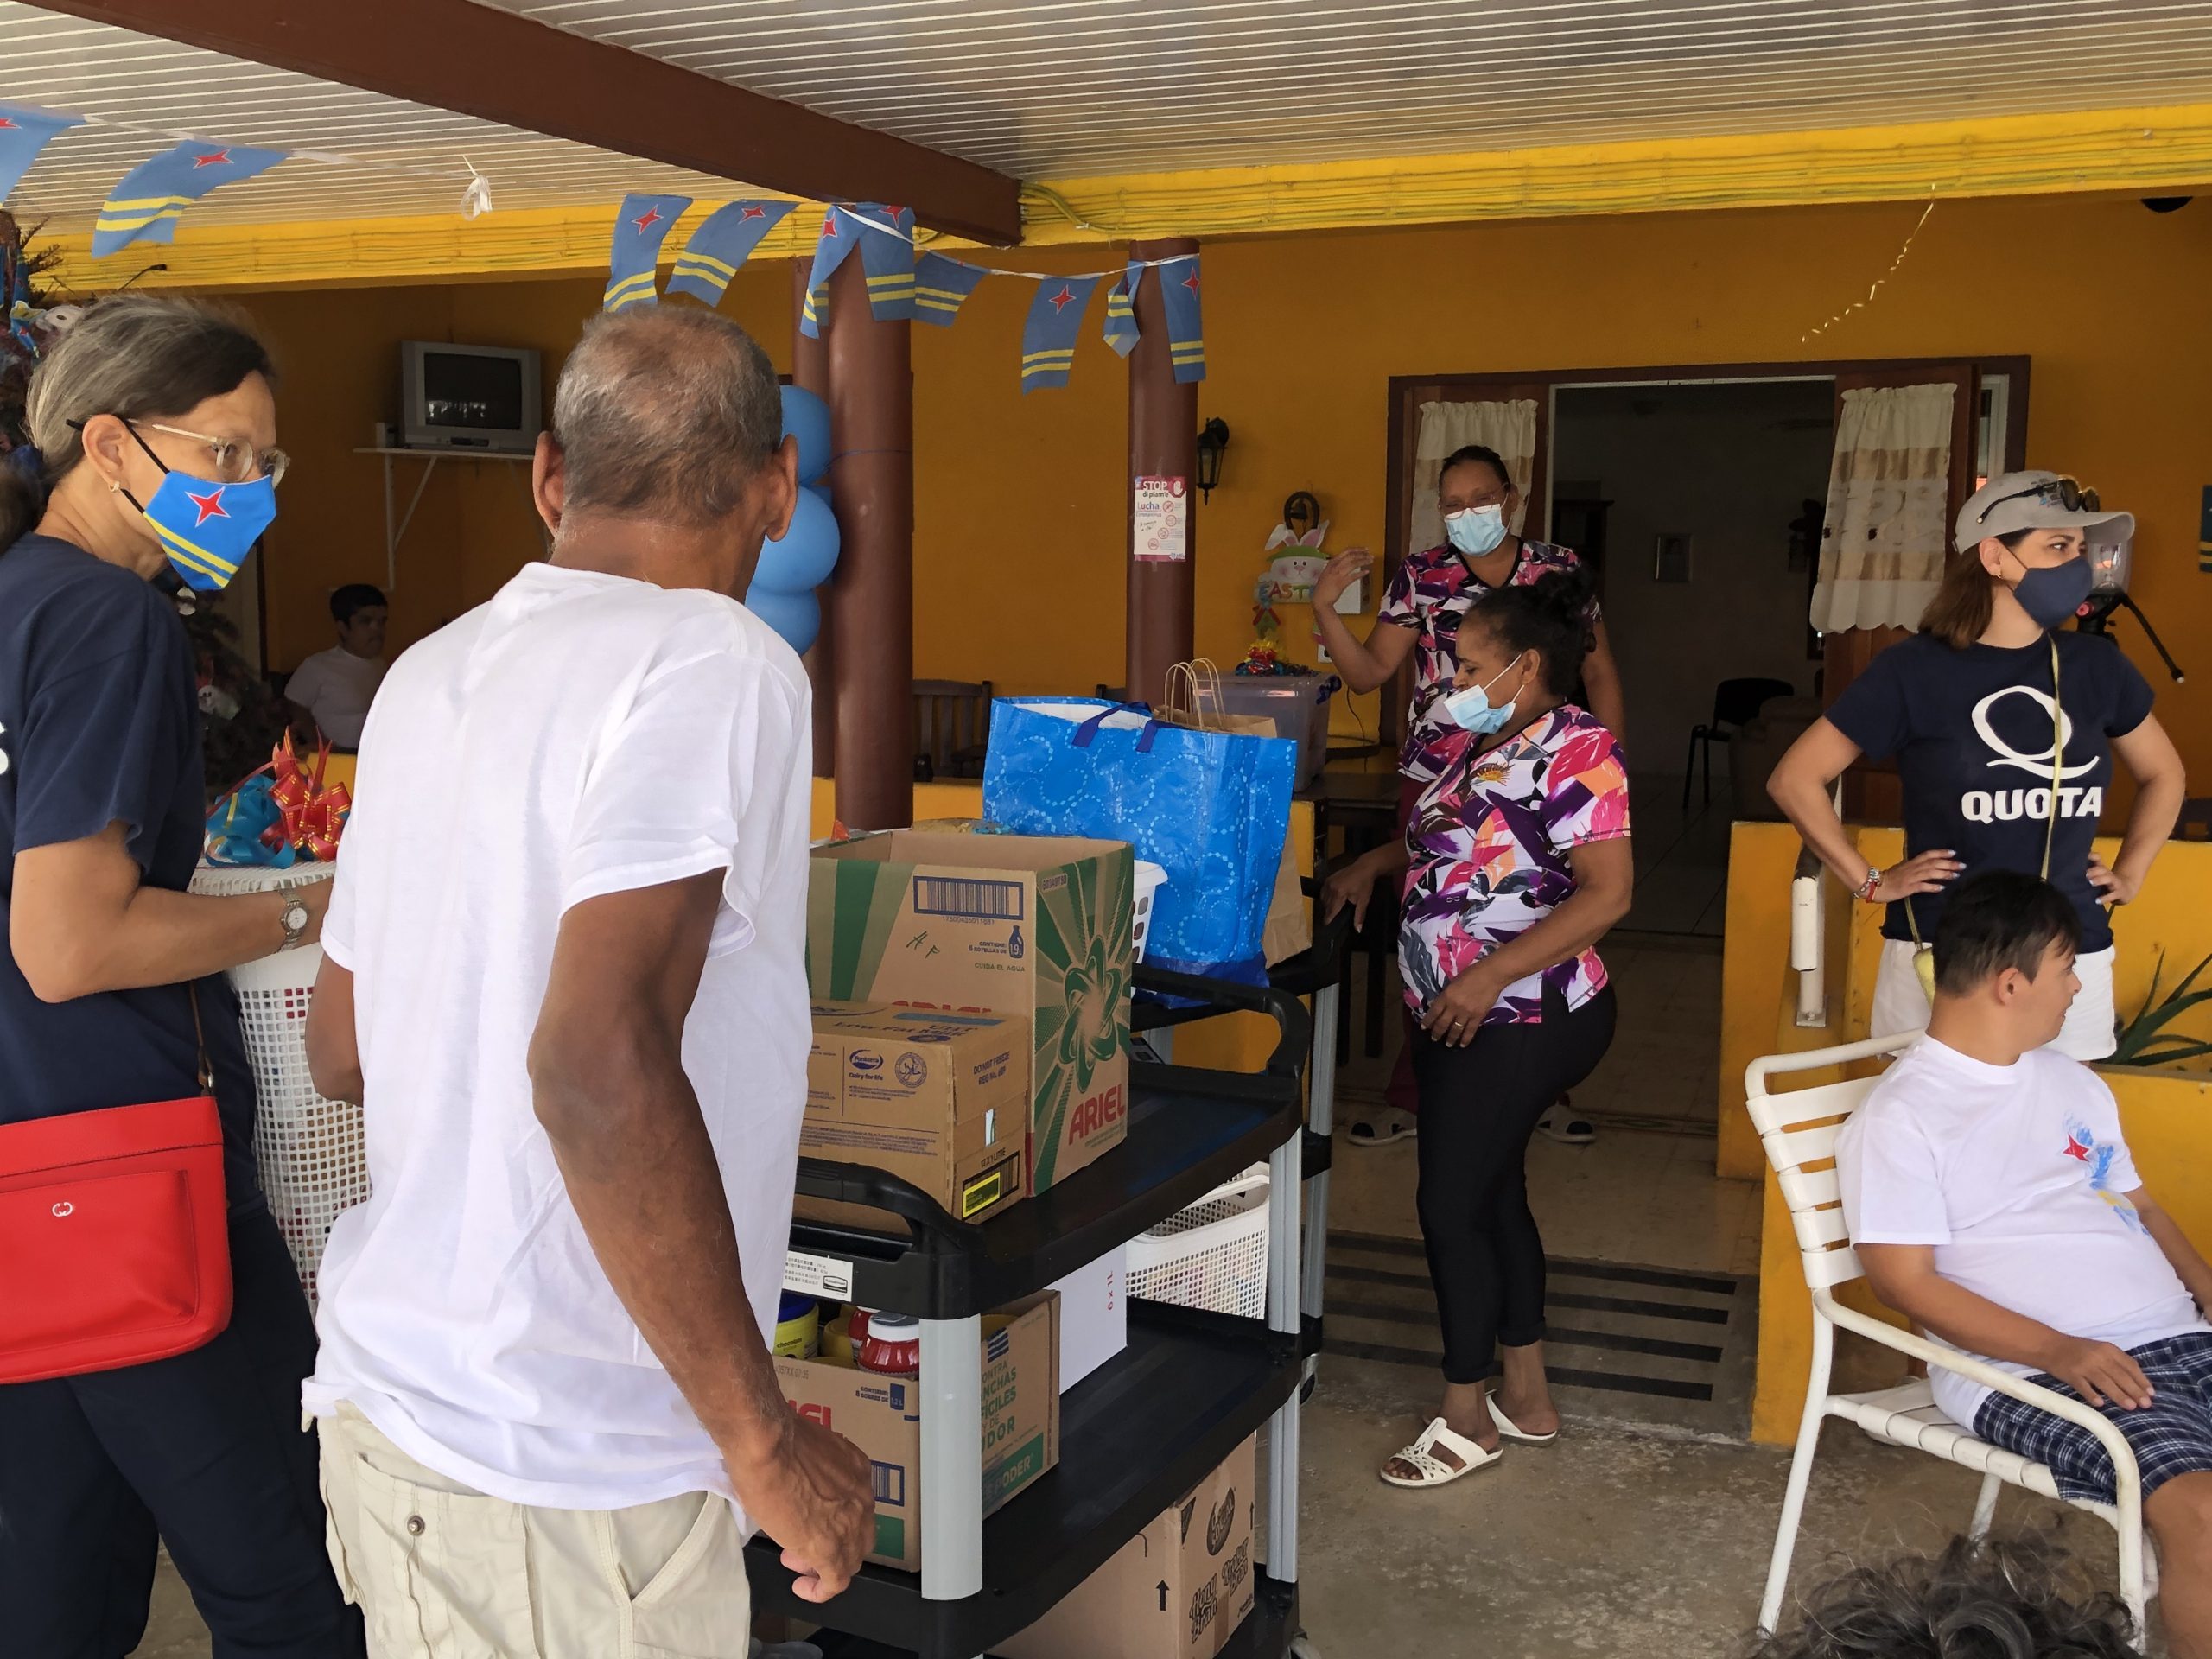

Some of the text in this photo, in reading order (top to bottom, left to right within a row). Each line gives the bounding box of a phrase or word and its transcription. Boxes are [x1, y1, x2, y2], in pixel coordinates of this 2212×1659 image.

[1142, 480, 1167, 491] STOP
[1137, 501, 1160, 510] Lucha
[1961, 786, 2102, 825] QUOTA
[973, 1064, 982, 1075] DO
[1069, 1083, 1126, 1146] ARIEL
[982, 1360, 1008, 1383] ONTRA
[981, 1367, 1017, 1402] NCHAS
